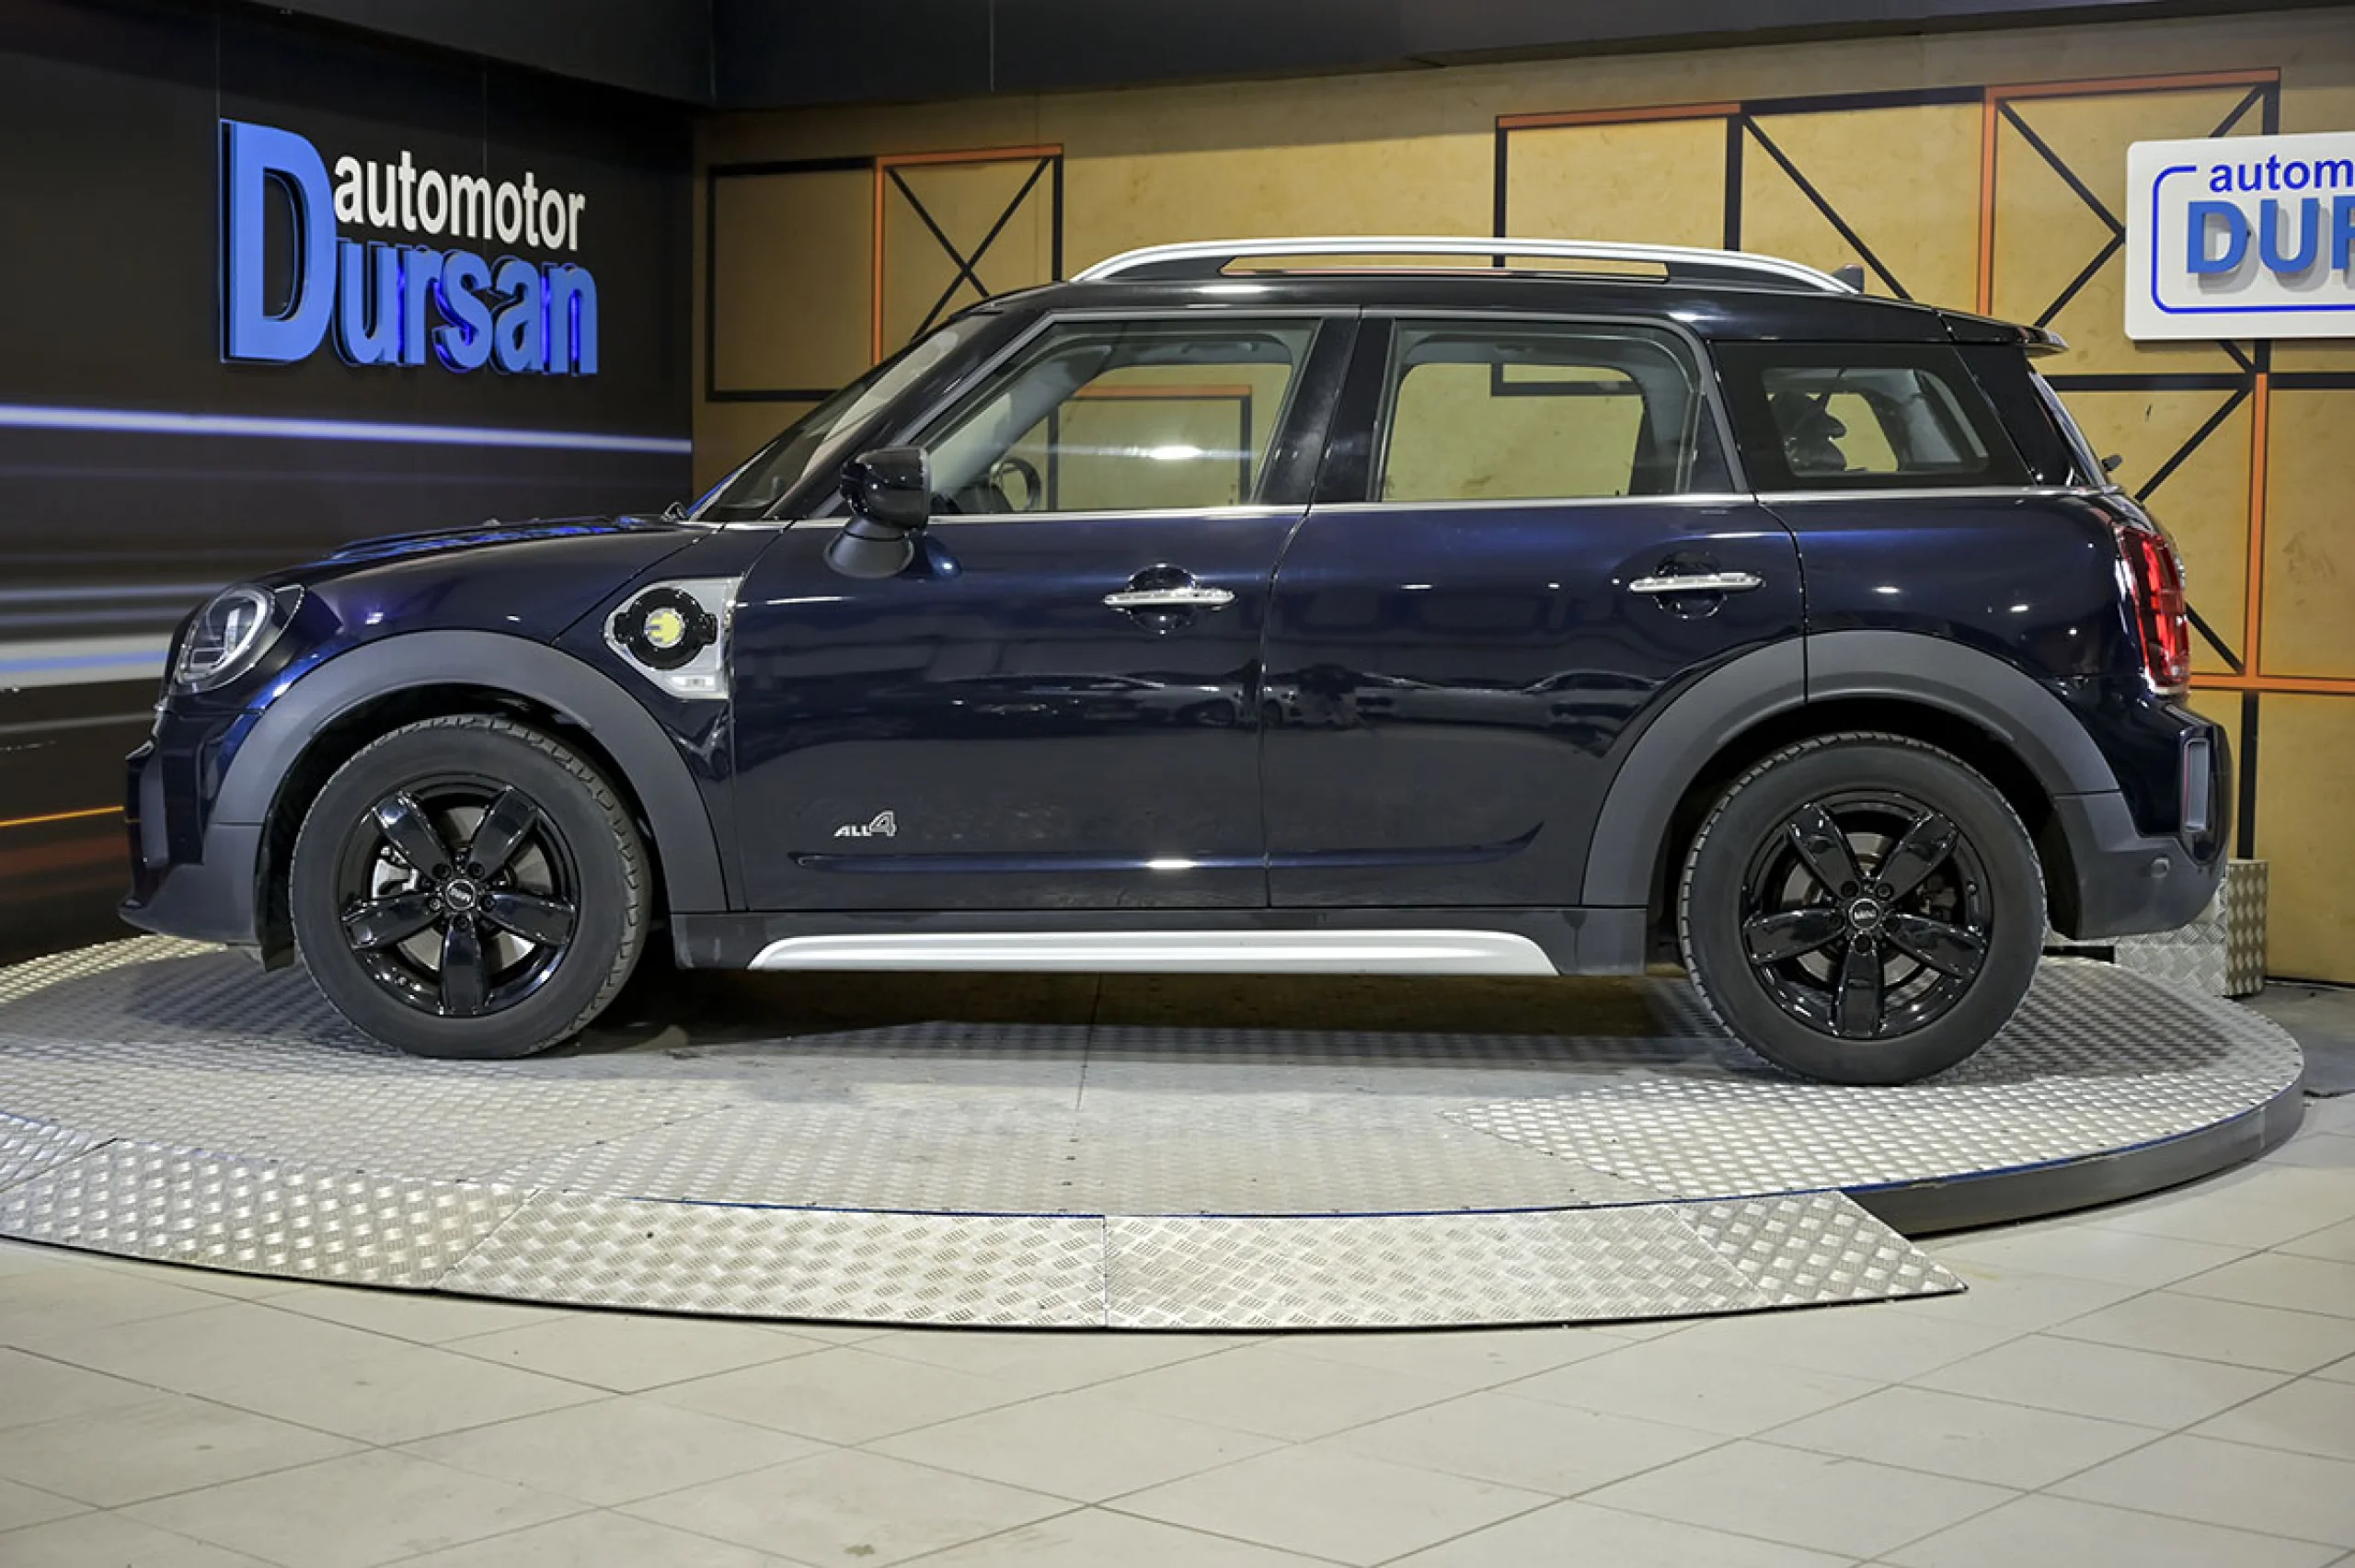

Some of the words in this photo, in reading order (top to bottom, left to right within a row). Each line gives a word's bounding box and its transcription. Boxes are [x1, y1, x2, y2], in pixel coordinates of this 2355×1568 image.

[220, 118, 599, 376] Dursan
[333, 150, 586, 251] automotor
[833, 810, 898, 837] ALL4
